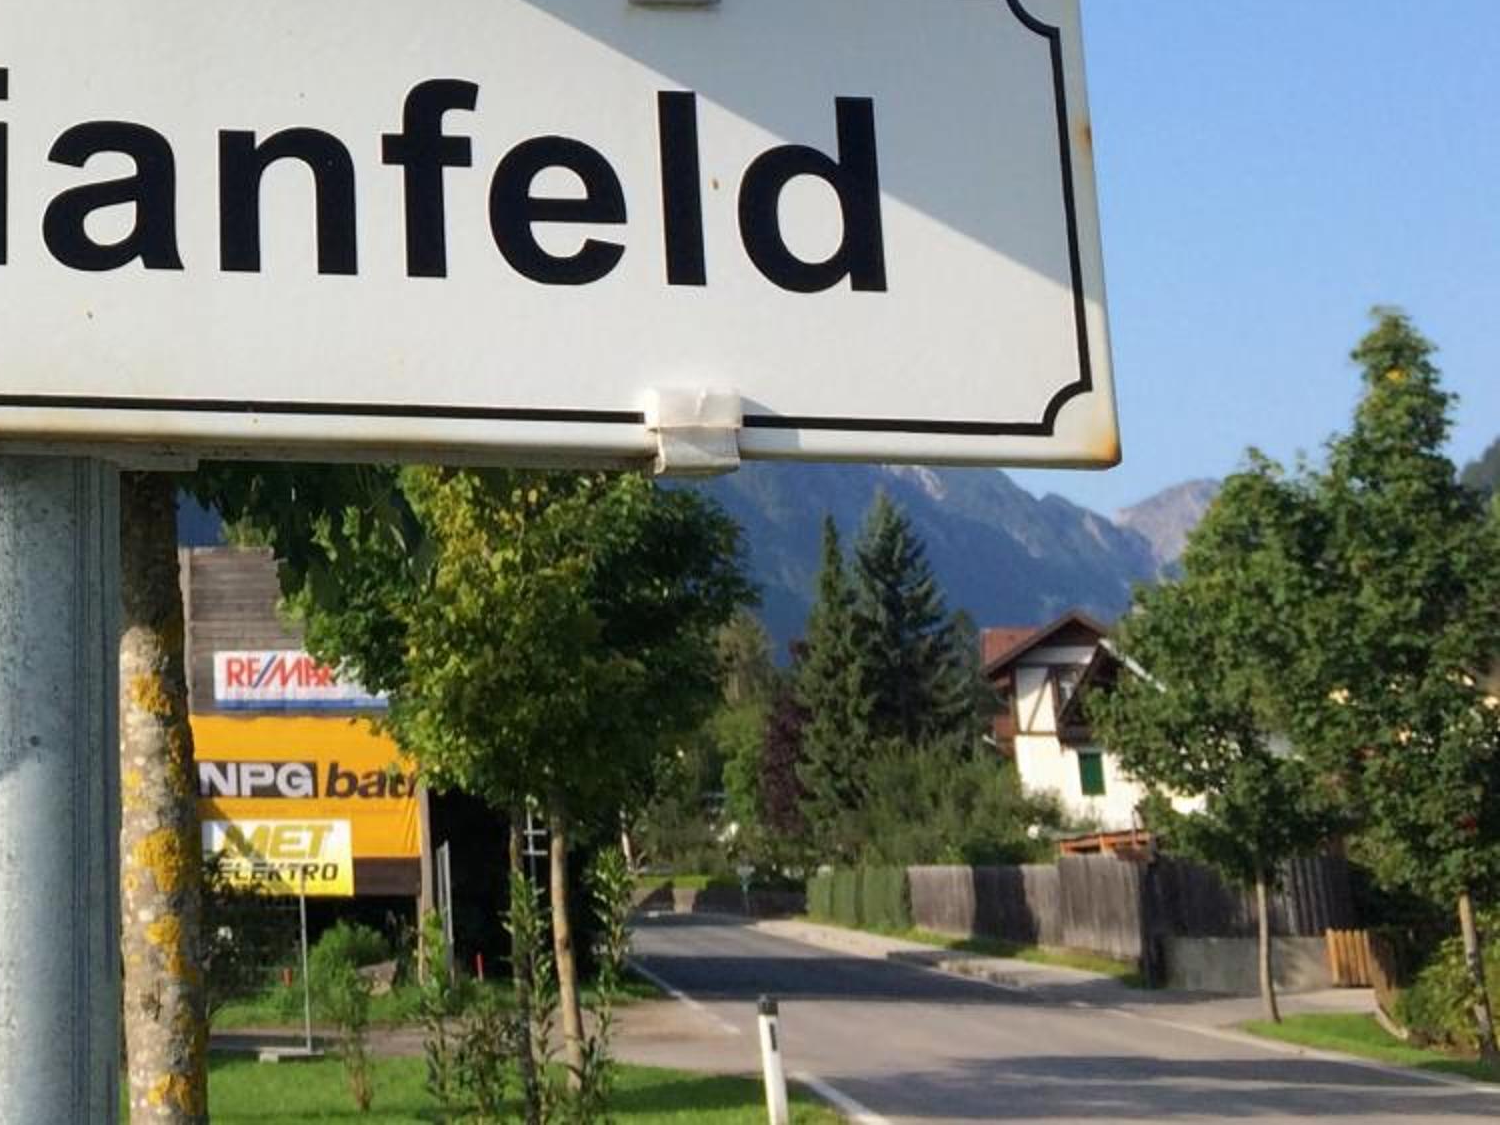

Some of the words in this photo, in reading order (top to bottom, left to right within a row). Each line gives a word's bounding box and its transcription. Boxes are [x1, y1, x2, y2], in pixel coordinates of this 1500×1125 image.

[199, 761, 314, 798] NPG
[222, 824, 334, 860] MET
[217, 862, 339, 882] ELEKTRO
